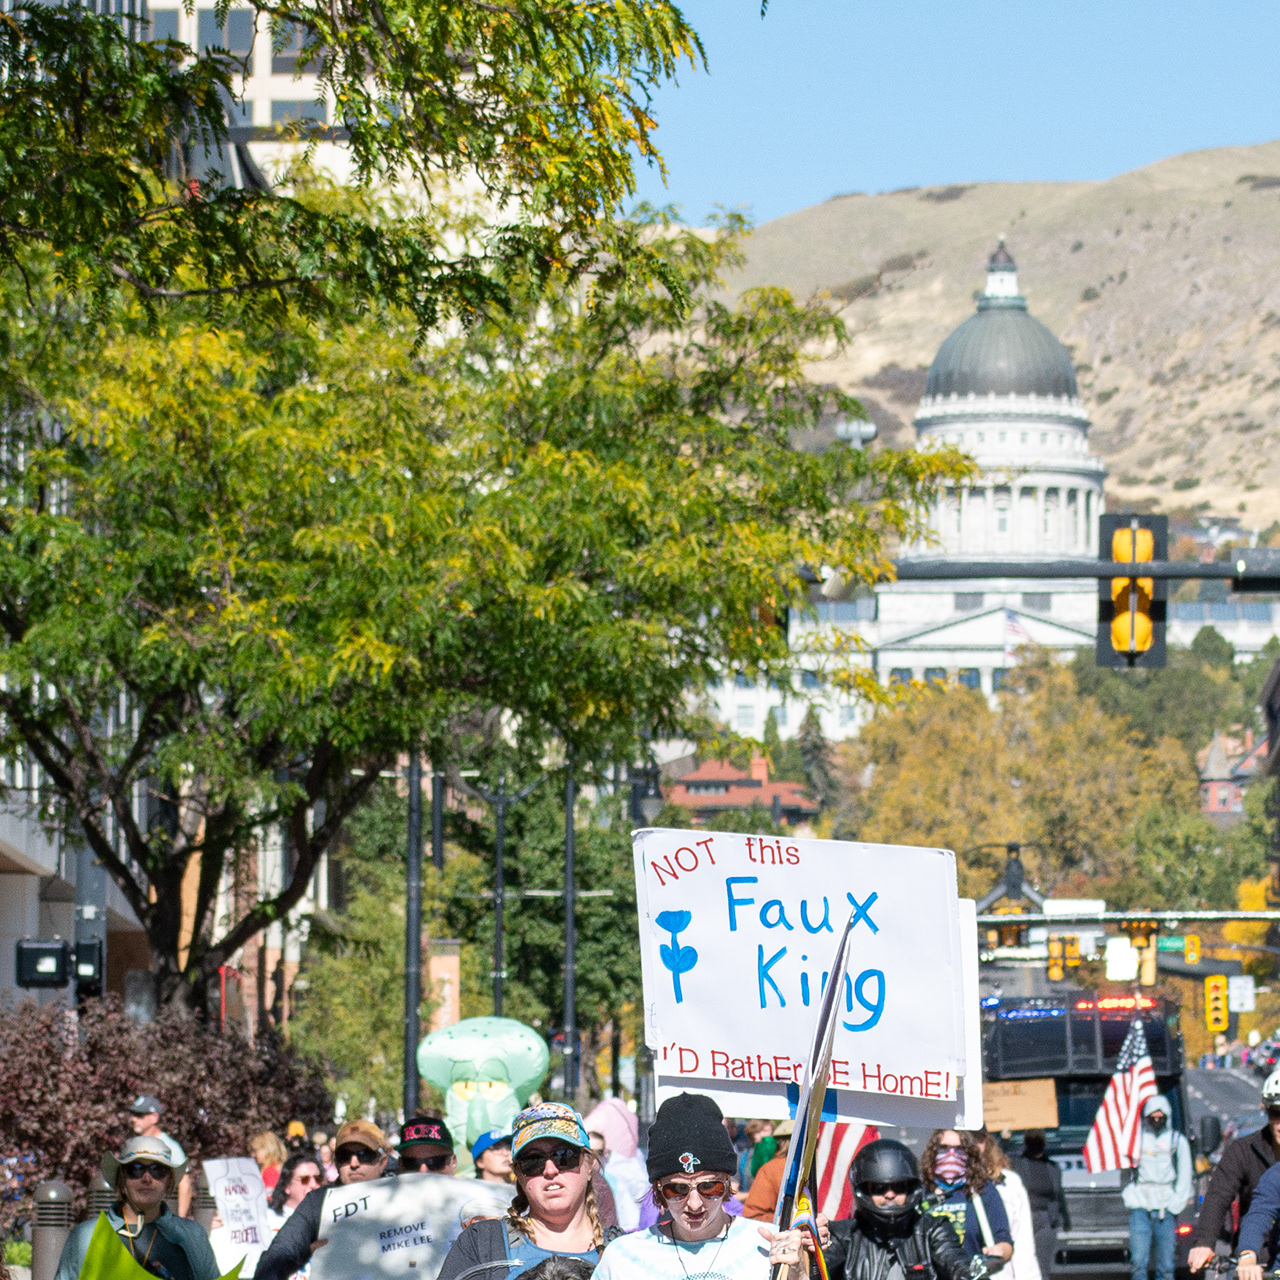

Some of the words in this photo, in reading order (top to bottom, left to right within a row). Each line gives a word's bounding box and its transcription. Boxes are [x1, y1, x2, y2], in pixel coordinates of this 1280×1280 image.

[650, 837, 717, 886] NOT
[745, 837, 801, 866] this
[725, 875, 880, 935] Faux
[757, 943, 886, 1033] King
[661, 1042, 700, 1074] I'D
[331, 1195, 372, 1224] FDT
[379, 1221, 428, 1241] REMOVE
[381, 1239, 411, 1255] MIKE
[413, 1234, 434, 1247] LEE
